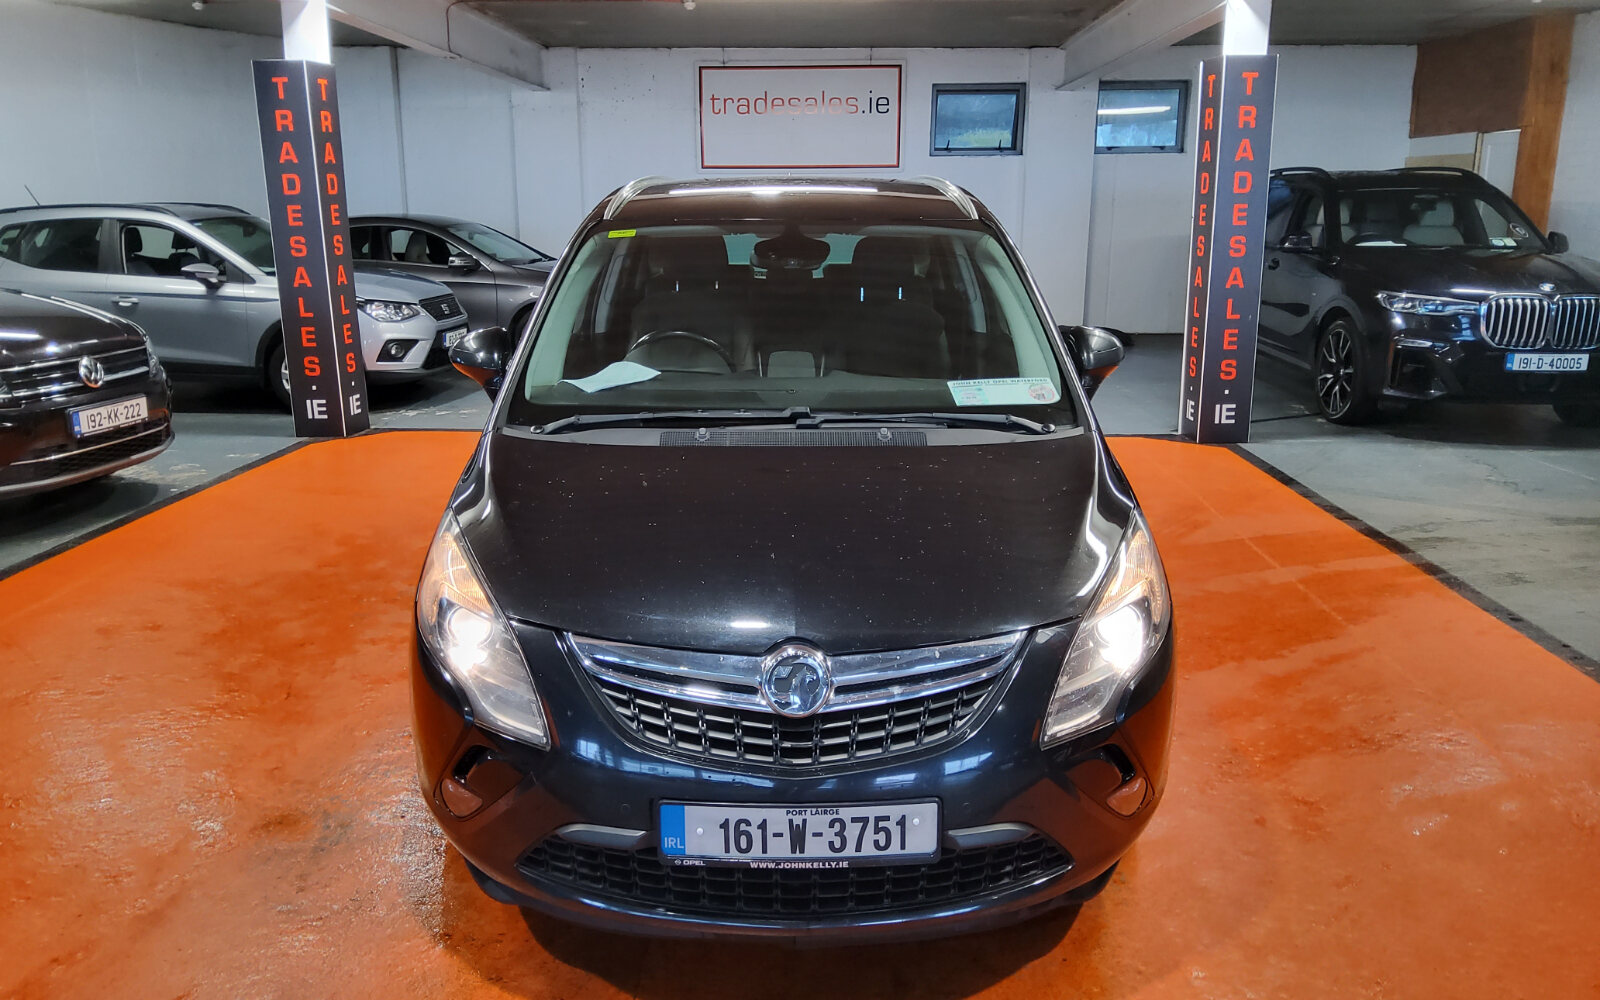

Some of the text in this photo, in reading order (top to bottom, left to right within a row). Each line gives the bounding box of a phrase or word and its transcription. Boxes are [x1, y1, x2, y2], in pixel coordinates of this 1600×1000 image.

[710, 90, 890, 115] tradesales.ie
[1518, 357, 1583, 369] 191-D-40005
[86, 402, 141, 430] 192-KK-222
[664, 837, 684, 849] IRL
[719, 814, 906, 855] 161-W-3751
[750, 861, 849, 869] WWW.JOHNKELLY.IE
